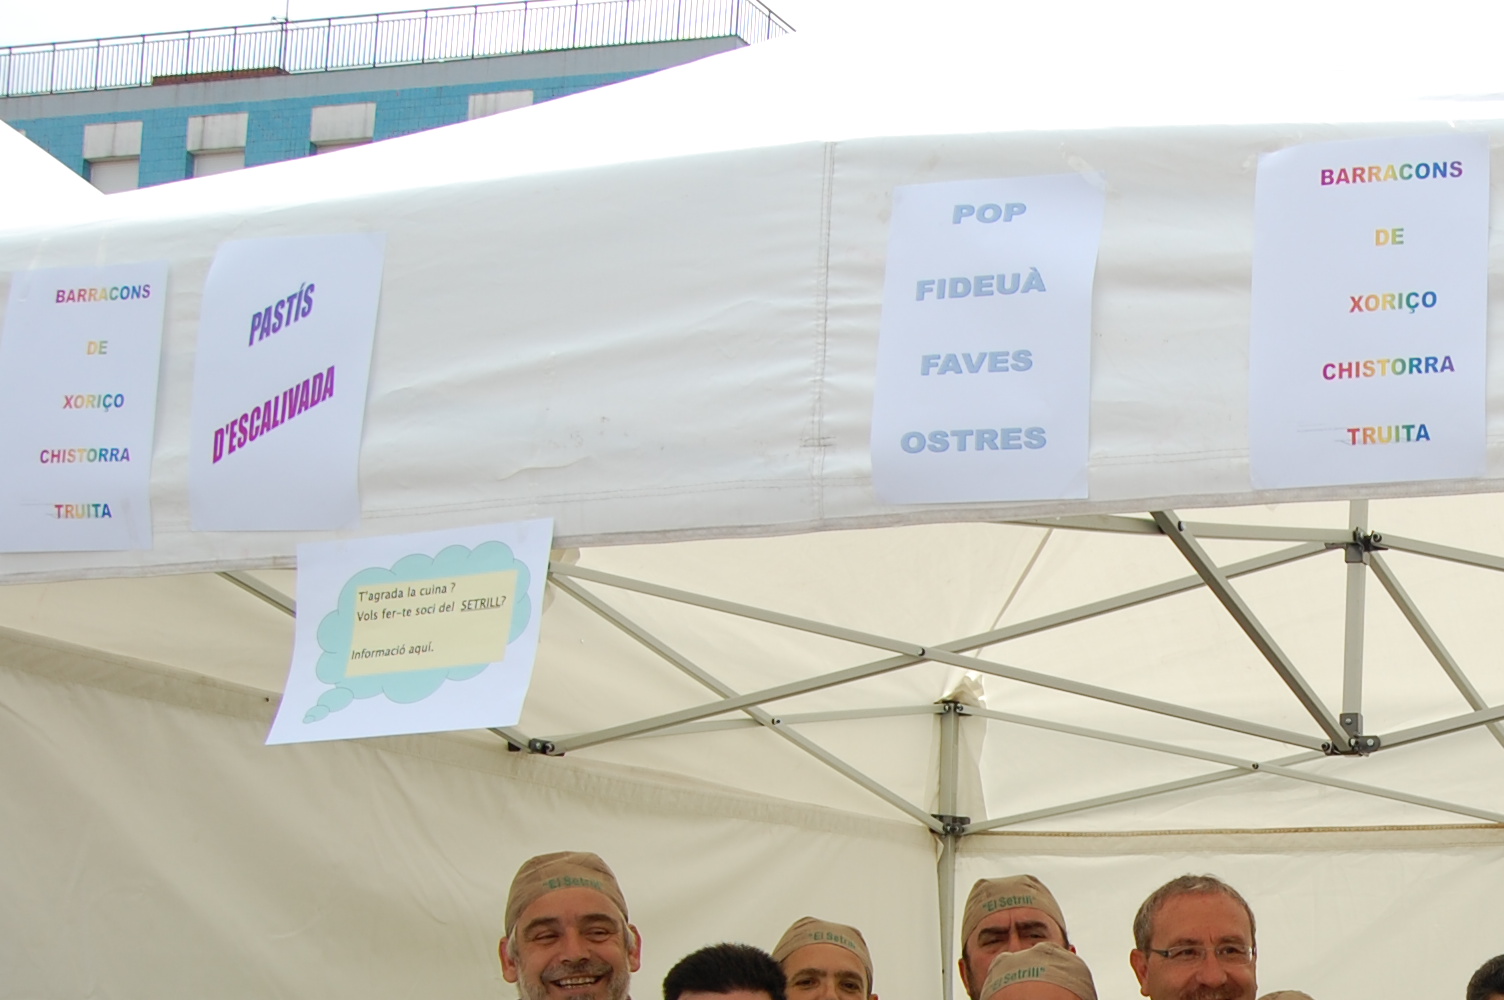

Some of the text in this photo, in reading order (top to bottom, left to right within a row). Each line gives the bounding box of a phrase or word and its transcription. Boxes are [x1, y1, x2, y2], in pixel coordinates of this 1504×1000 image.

[1321, 160, 1463, 186] BARRACONS
[953, 202, 1027, 225] POP
[1374, 228, 1405, 247] DE
[56, 284, 151, 304] BARRACONS
[915, 266, 1047, 302] FIDEUÀ
[1349, 290, 1438, 314] XORIÇO
[249, 281, 316, 347] PASTÍS
[86, 340, 109, 356] DE
[920, 349, 1034, 377] FAVES
[1322, 355, 1456, 381] CHISTORRA
[62, 393, 125, 412] XORIÇO
[212, 365, 336, 465] D'ESCALIVADA
[900, 426, 1047, 455] OSTRES
[1346, 423, 1431, 446] TRUITA
[39, 447, 131, 464] CHISTORRA
[54, 503, 113, 519] TRUITA
[358, 588, 404, 603] T'agrada
[407, 586, 416, 598] la
[419, 584, 448, 597] cuina
[356, 595, 507, 622] Vols fer-te soci del SETRILL?
[351, 641, 434, 660] Informació aquí.
